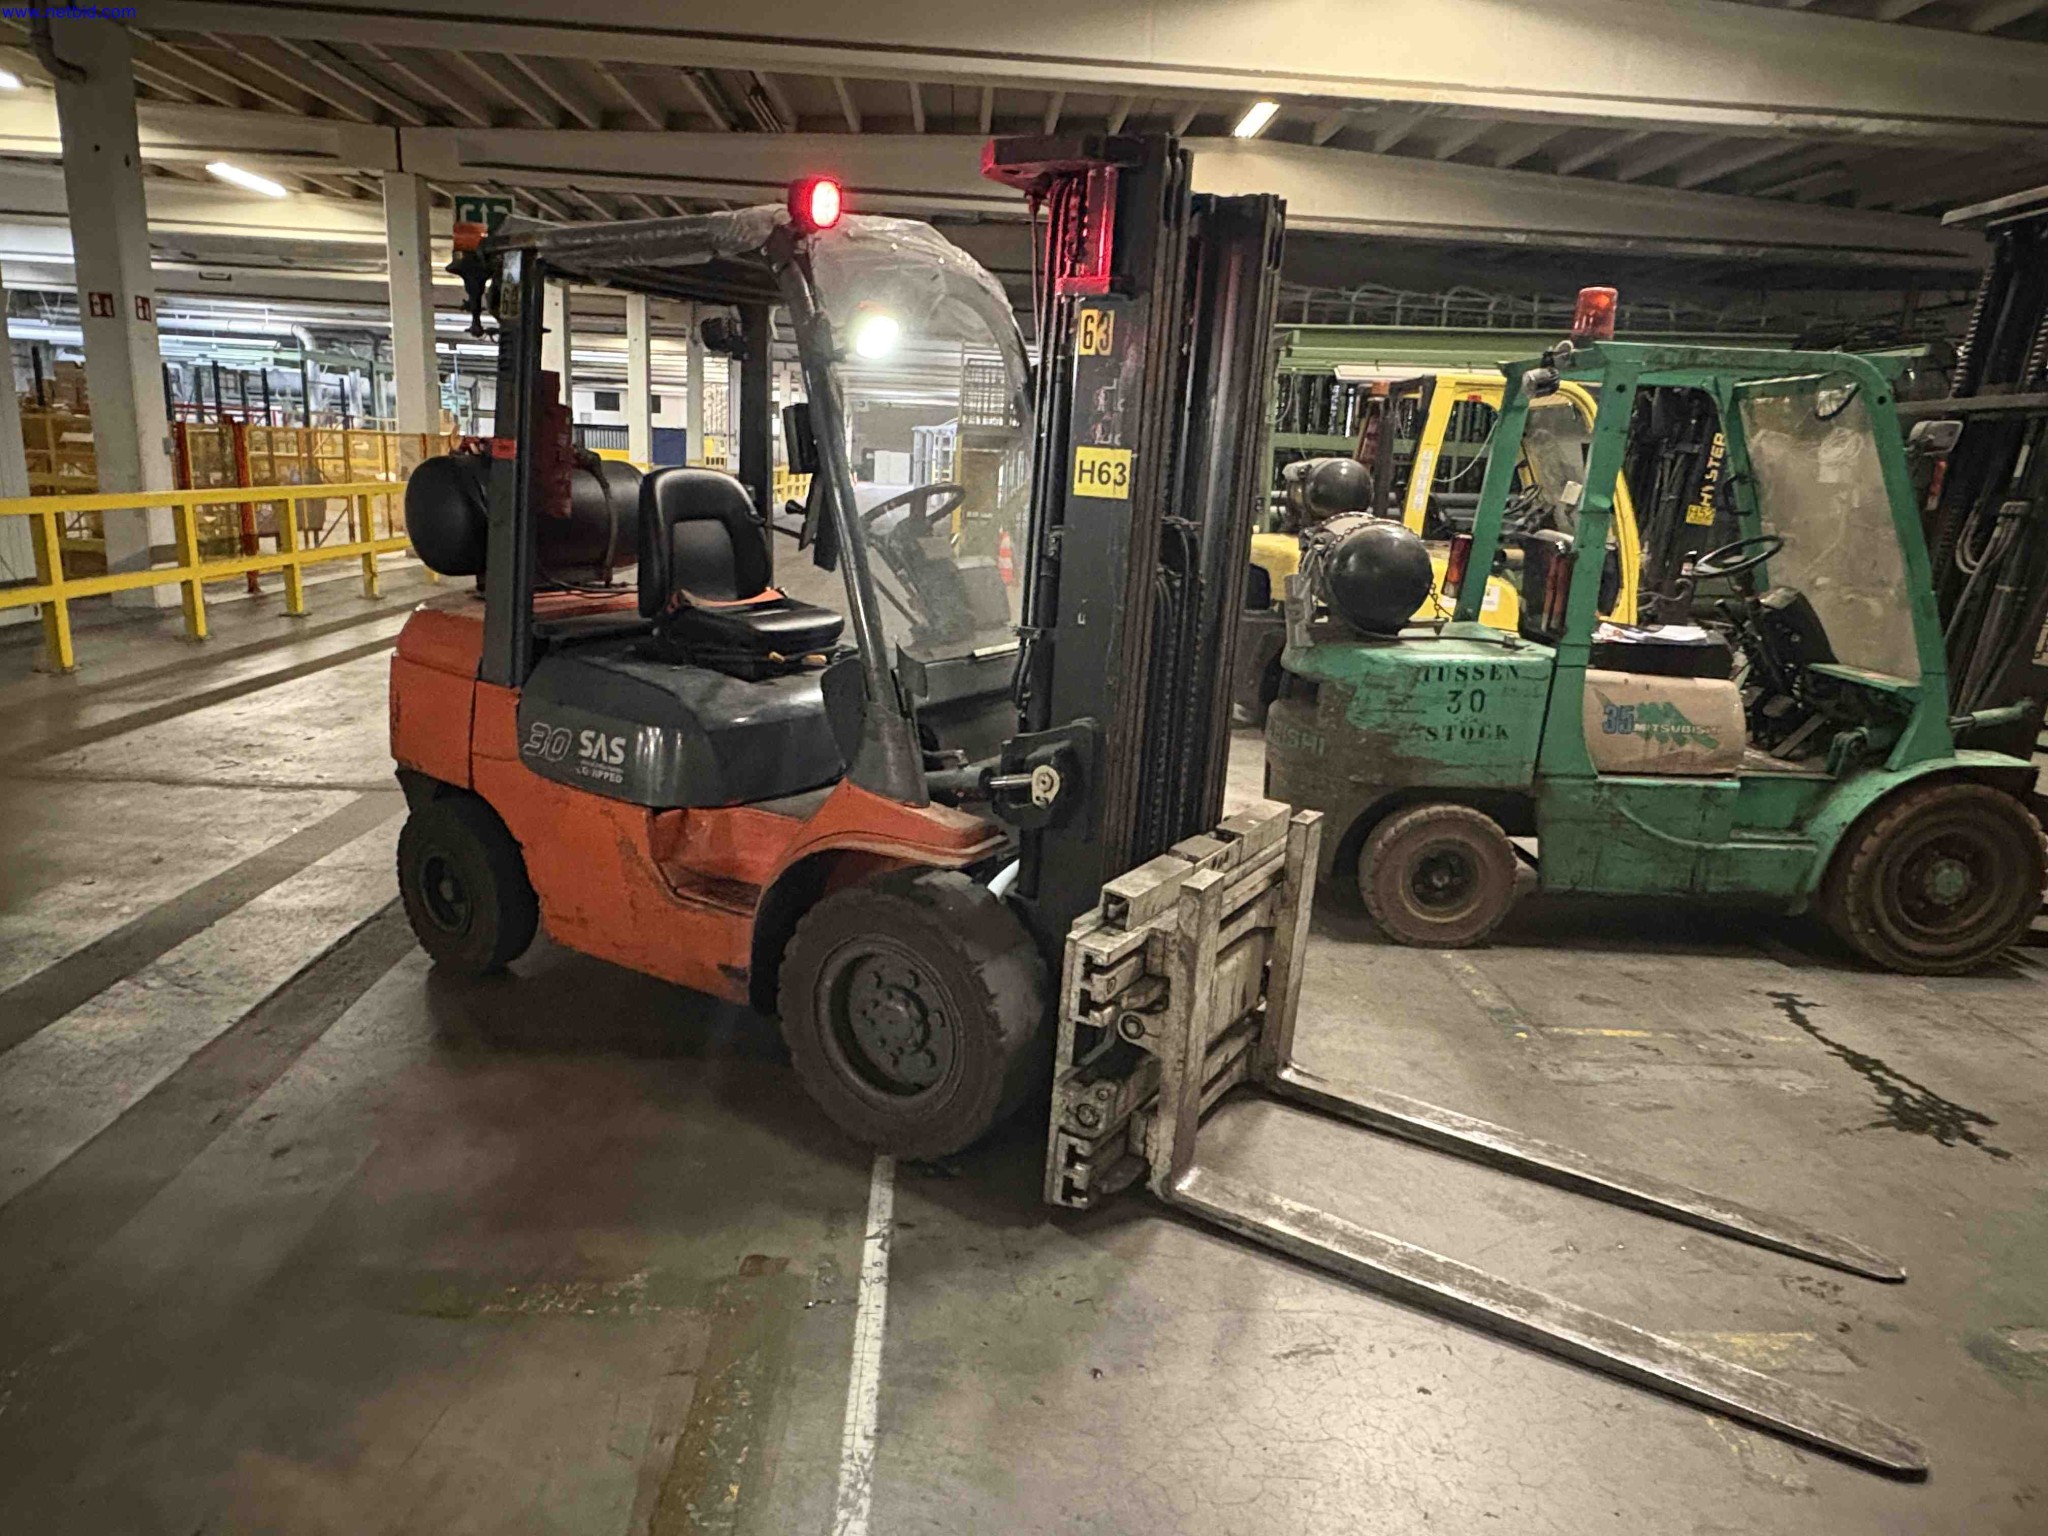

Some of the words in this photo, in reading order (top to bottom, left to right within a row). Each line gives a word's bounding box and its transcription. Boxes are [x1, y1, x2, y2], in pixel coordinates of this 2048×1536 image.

[1082, 314, 1111, 352] 63
[1077, 459, 1127, 487] H63
[1446, 688, 1486, 715] 30
[1424, 723, 1510, 742] STOCK
[1602, 703, 1635, 735] 35
[522, 721, 573, 762] 30
[579, 729, 626, 765] SAS
